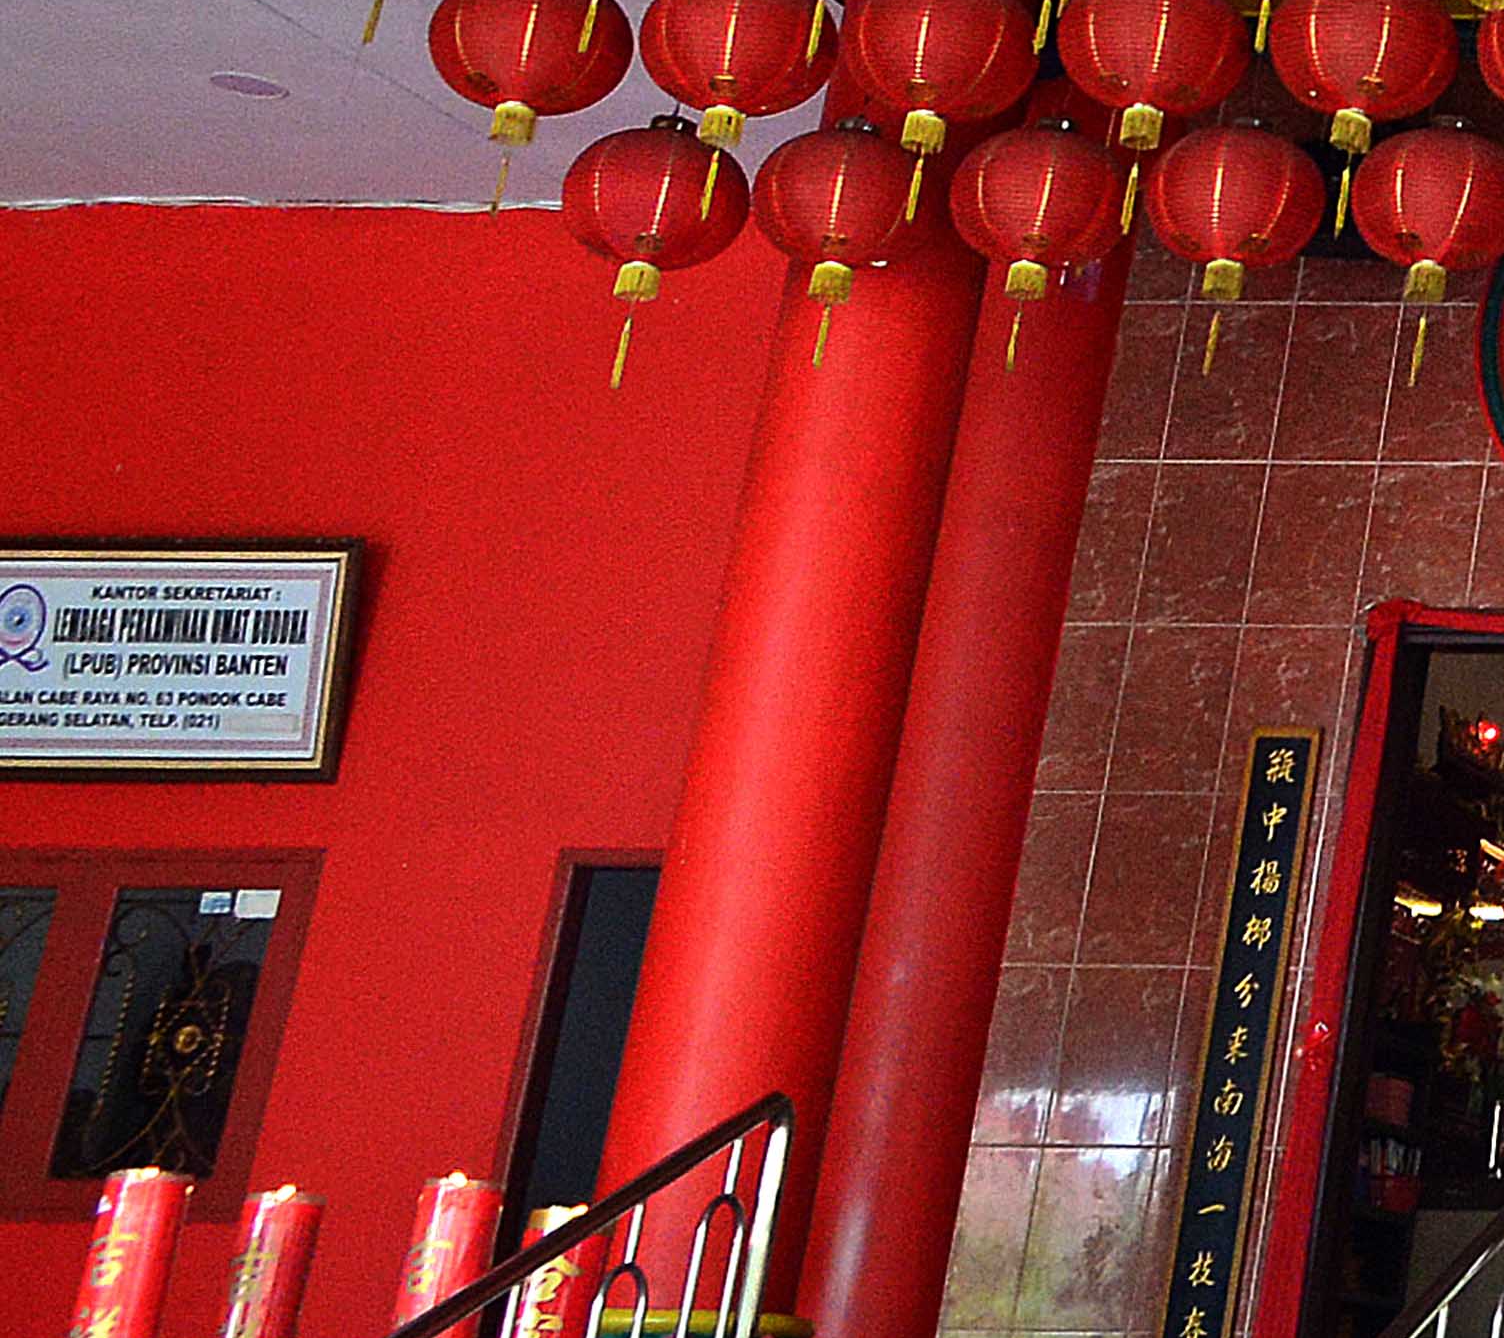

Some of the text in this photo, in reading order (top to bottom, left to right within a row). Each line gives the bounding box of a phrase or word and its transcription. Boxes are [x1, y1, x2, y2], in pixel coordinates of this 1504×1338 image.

[92, 585, 158, 601] KANTOR
[163, 586, 272, 602] SEKRETARIAT
[64, 652, 289, 679] (LPUB) PROVINSI BANTEN
[83, 691, 121, 706] RAYA
[177, 693, 241, 707] PONDOK
